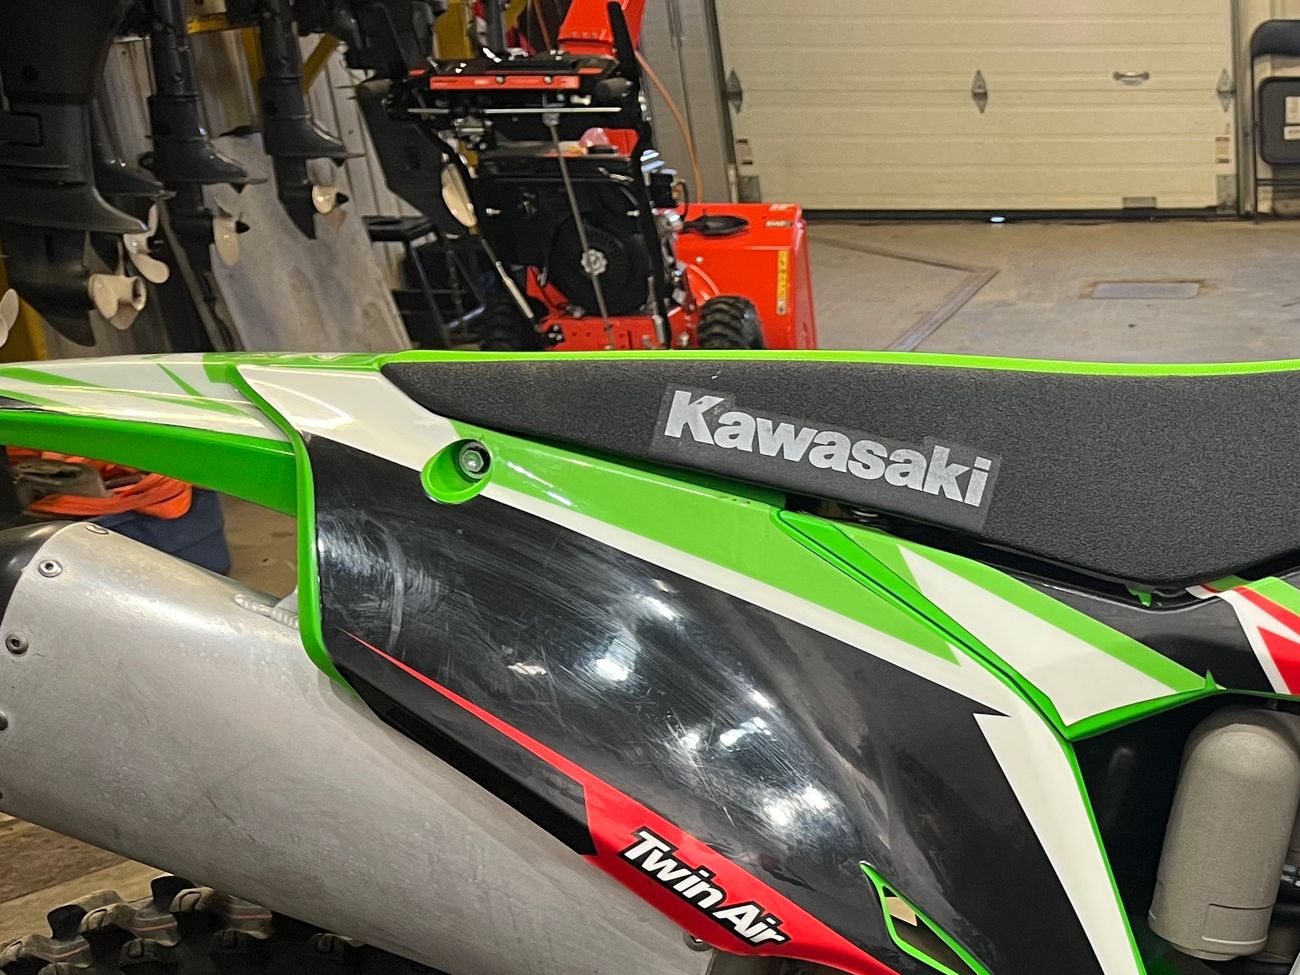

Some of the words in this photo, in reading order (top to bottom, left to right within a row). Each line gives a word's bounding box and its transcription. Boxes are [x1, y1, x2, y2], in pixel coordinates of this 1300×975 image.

[664, 390, 992, 507] Kawasaki
[624, 830, 724, 909] Twin
[711, 904, 786, 943] Air
